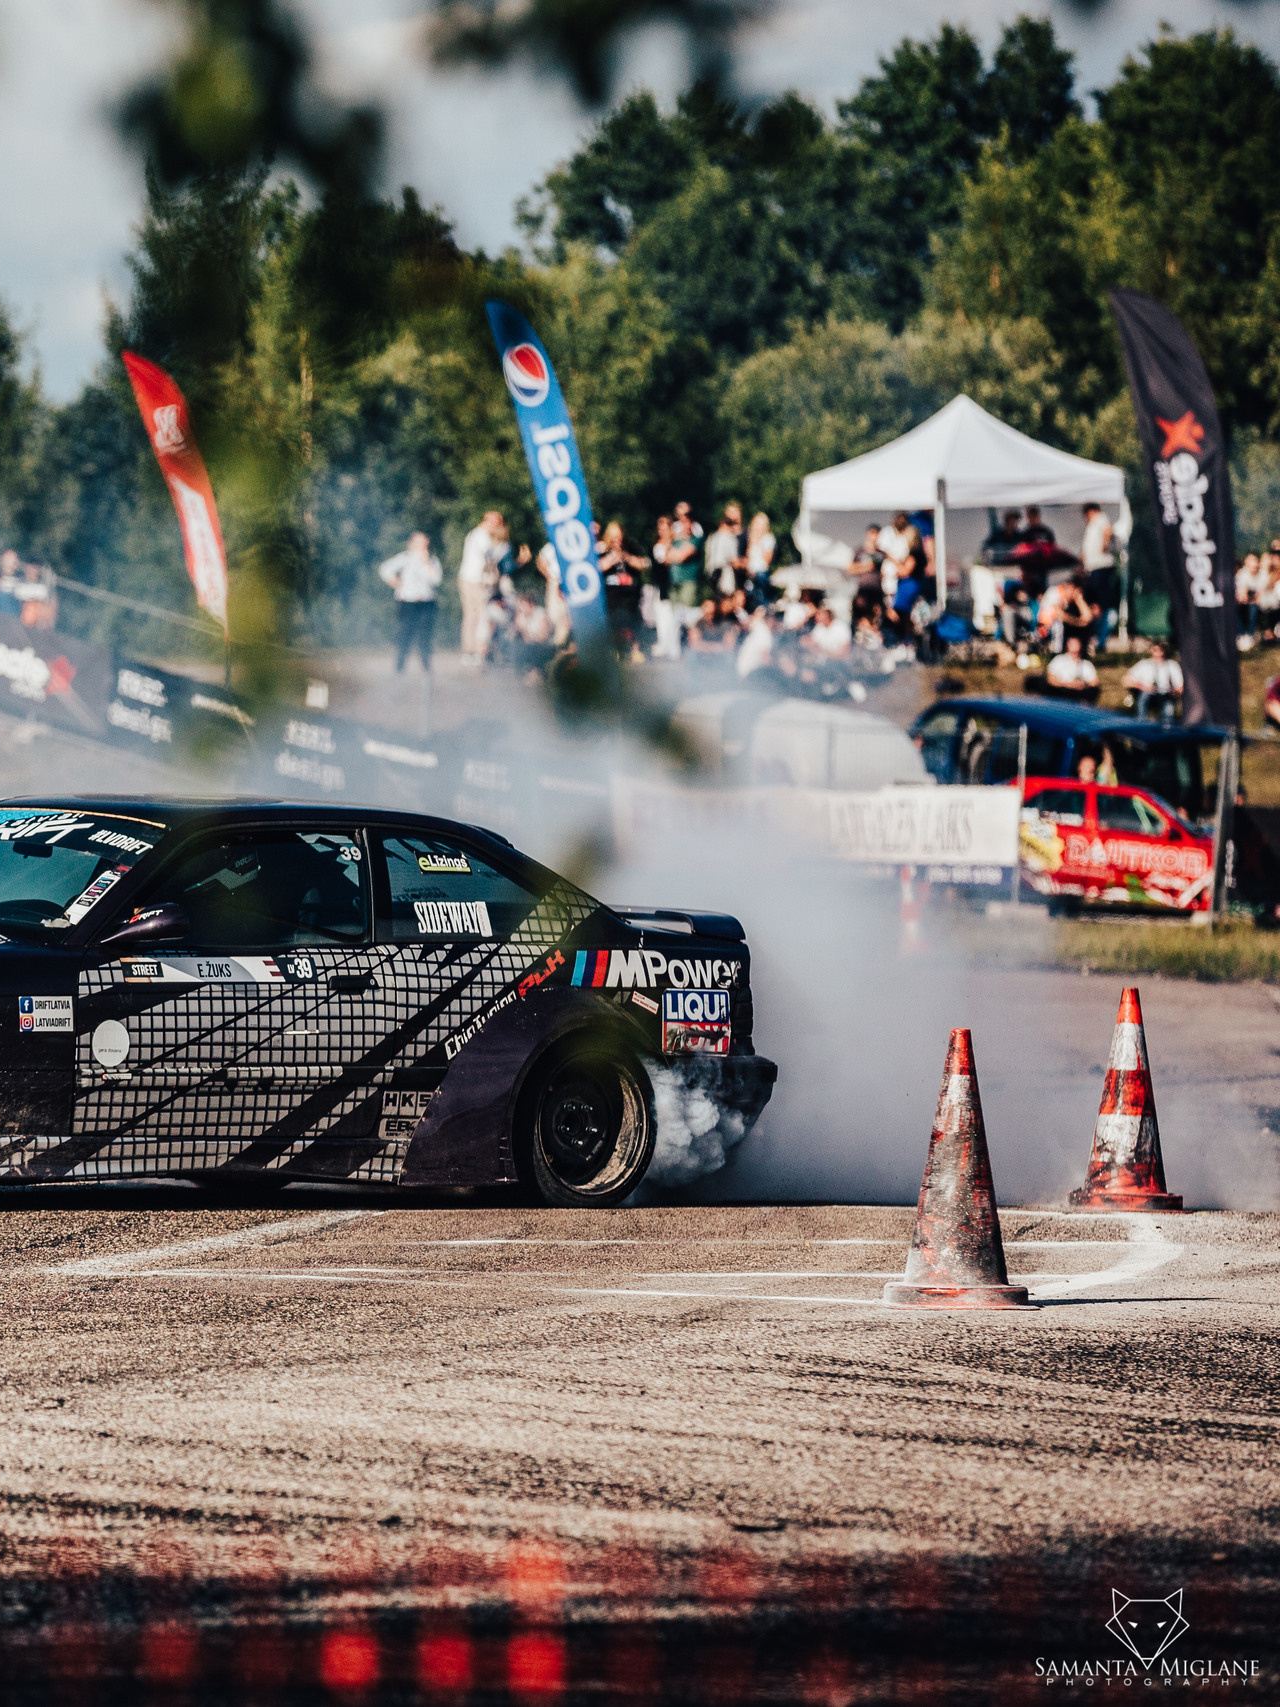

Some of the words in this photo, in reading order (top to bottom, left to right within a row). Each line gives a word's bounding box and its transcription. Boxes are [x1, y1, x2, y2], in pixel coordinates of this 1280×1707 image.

[88, 829, 153, 855] #LVDRIFT
[340, 846, 361, 861] 39
[414, 901, 481, 935] SIDEWAY
[132, 964, 158, 976] STREET
[294, 958, 313, 979] 39
[34, 1000, 70, 1010] DRIFTLATVIA
[666, 992, 727, 1022] LIQUI
[35, 1018, 71, 1028] LATVIADRIFT
[385, 1093, 432, 1107] HKS
